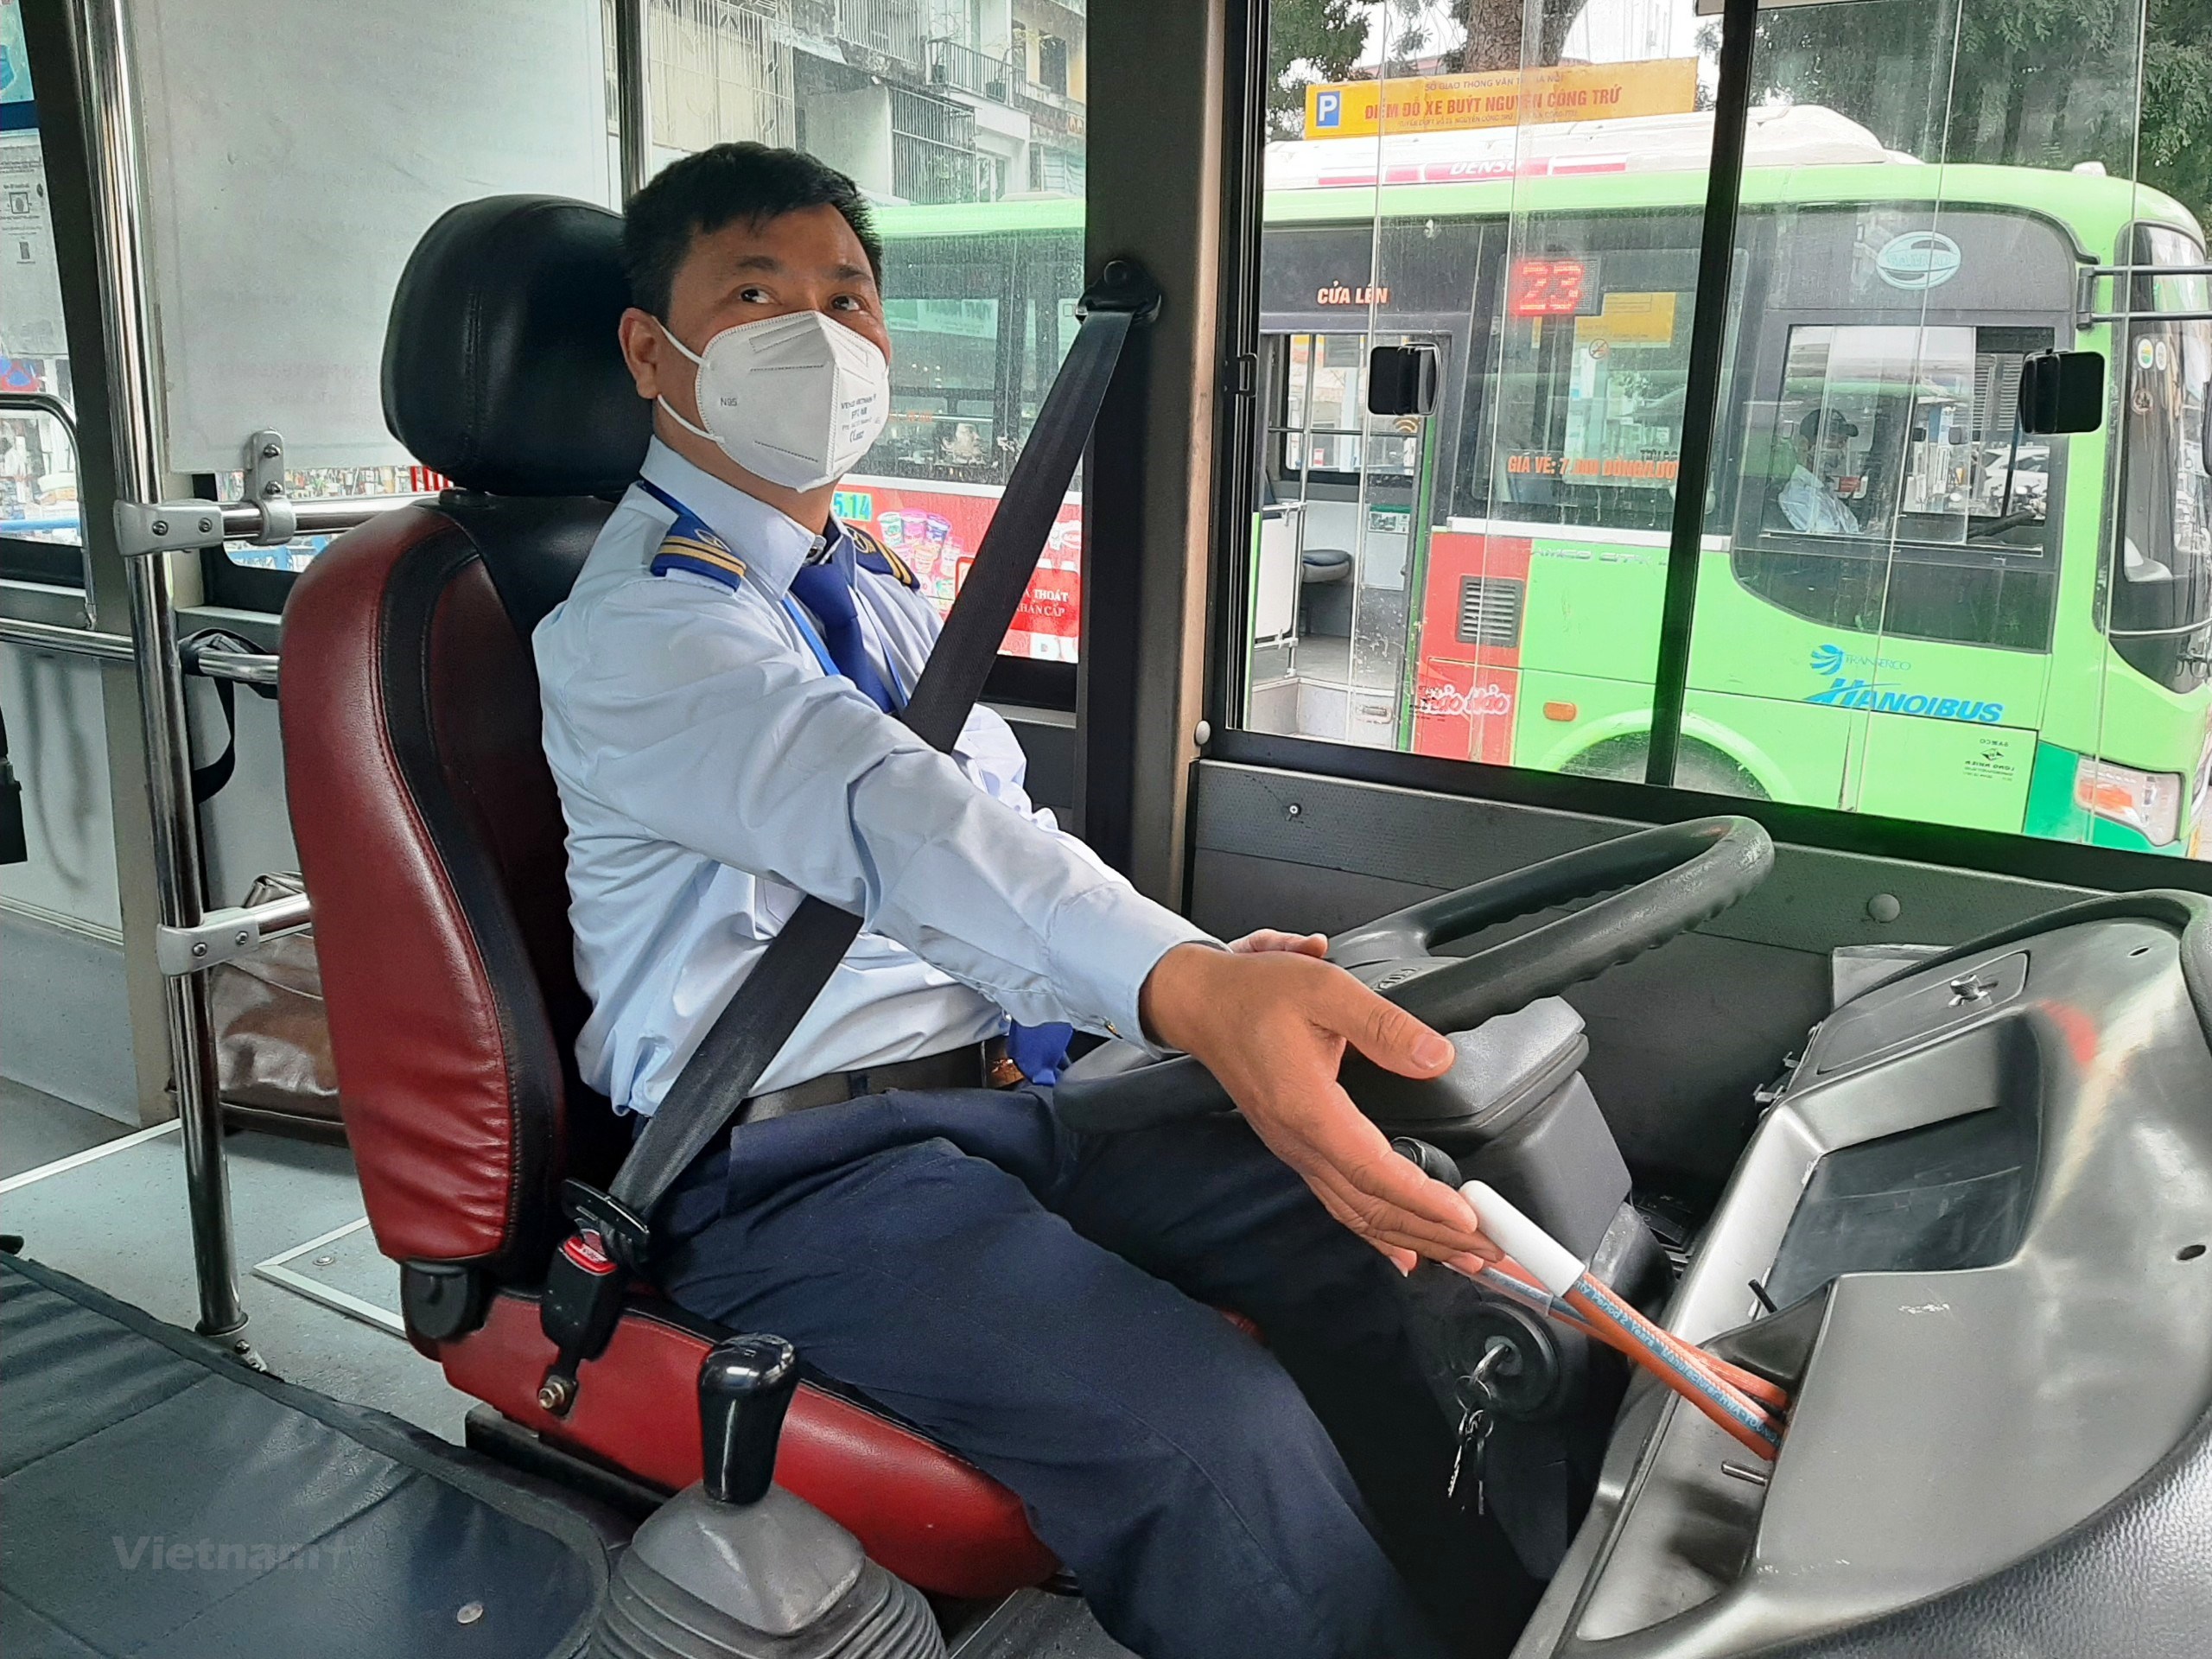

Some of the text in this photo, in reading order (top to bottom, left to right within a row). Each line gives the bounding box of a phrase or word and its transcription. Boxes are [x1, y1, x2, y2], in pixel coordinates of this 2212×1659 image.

[1319, 96, 1338, 122] P
[1425, 100, 1443, 116] XE
[1447, 94, 1481, 115] BUÝT
[1547, 88, 1586, 108] CÔNG
[1592, 84, 1623, 105] TRỨ
[1318, 280, 1351, 305] CỬA
[1516, 263, 1585, 312] 23
[720, 397, 738, 407] N95
[1034, 588, 1070, 602] THOÁT
[1802, 678, 2005, 724] HANOIBUS
[1591, 1289, 1621, 1320] Period
[1629, 1321, 1656, 1348] Years
